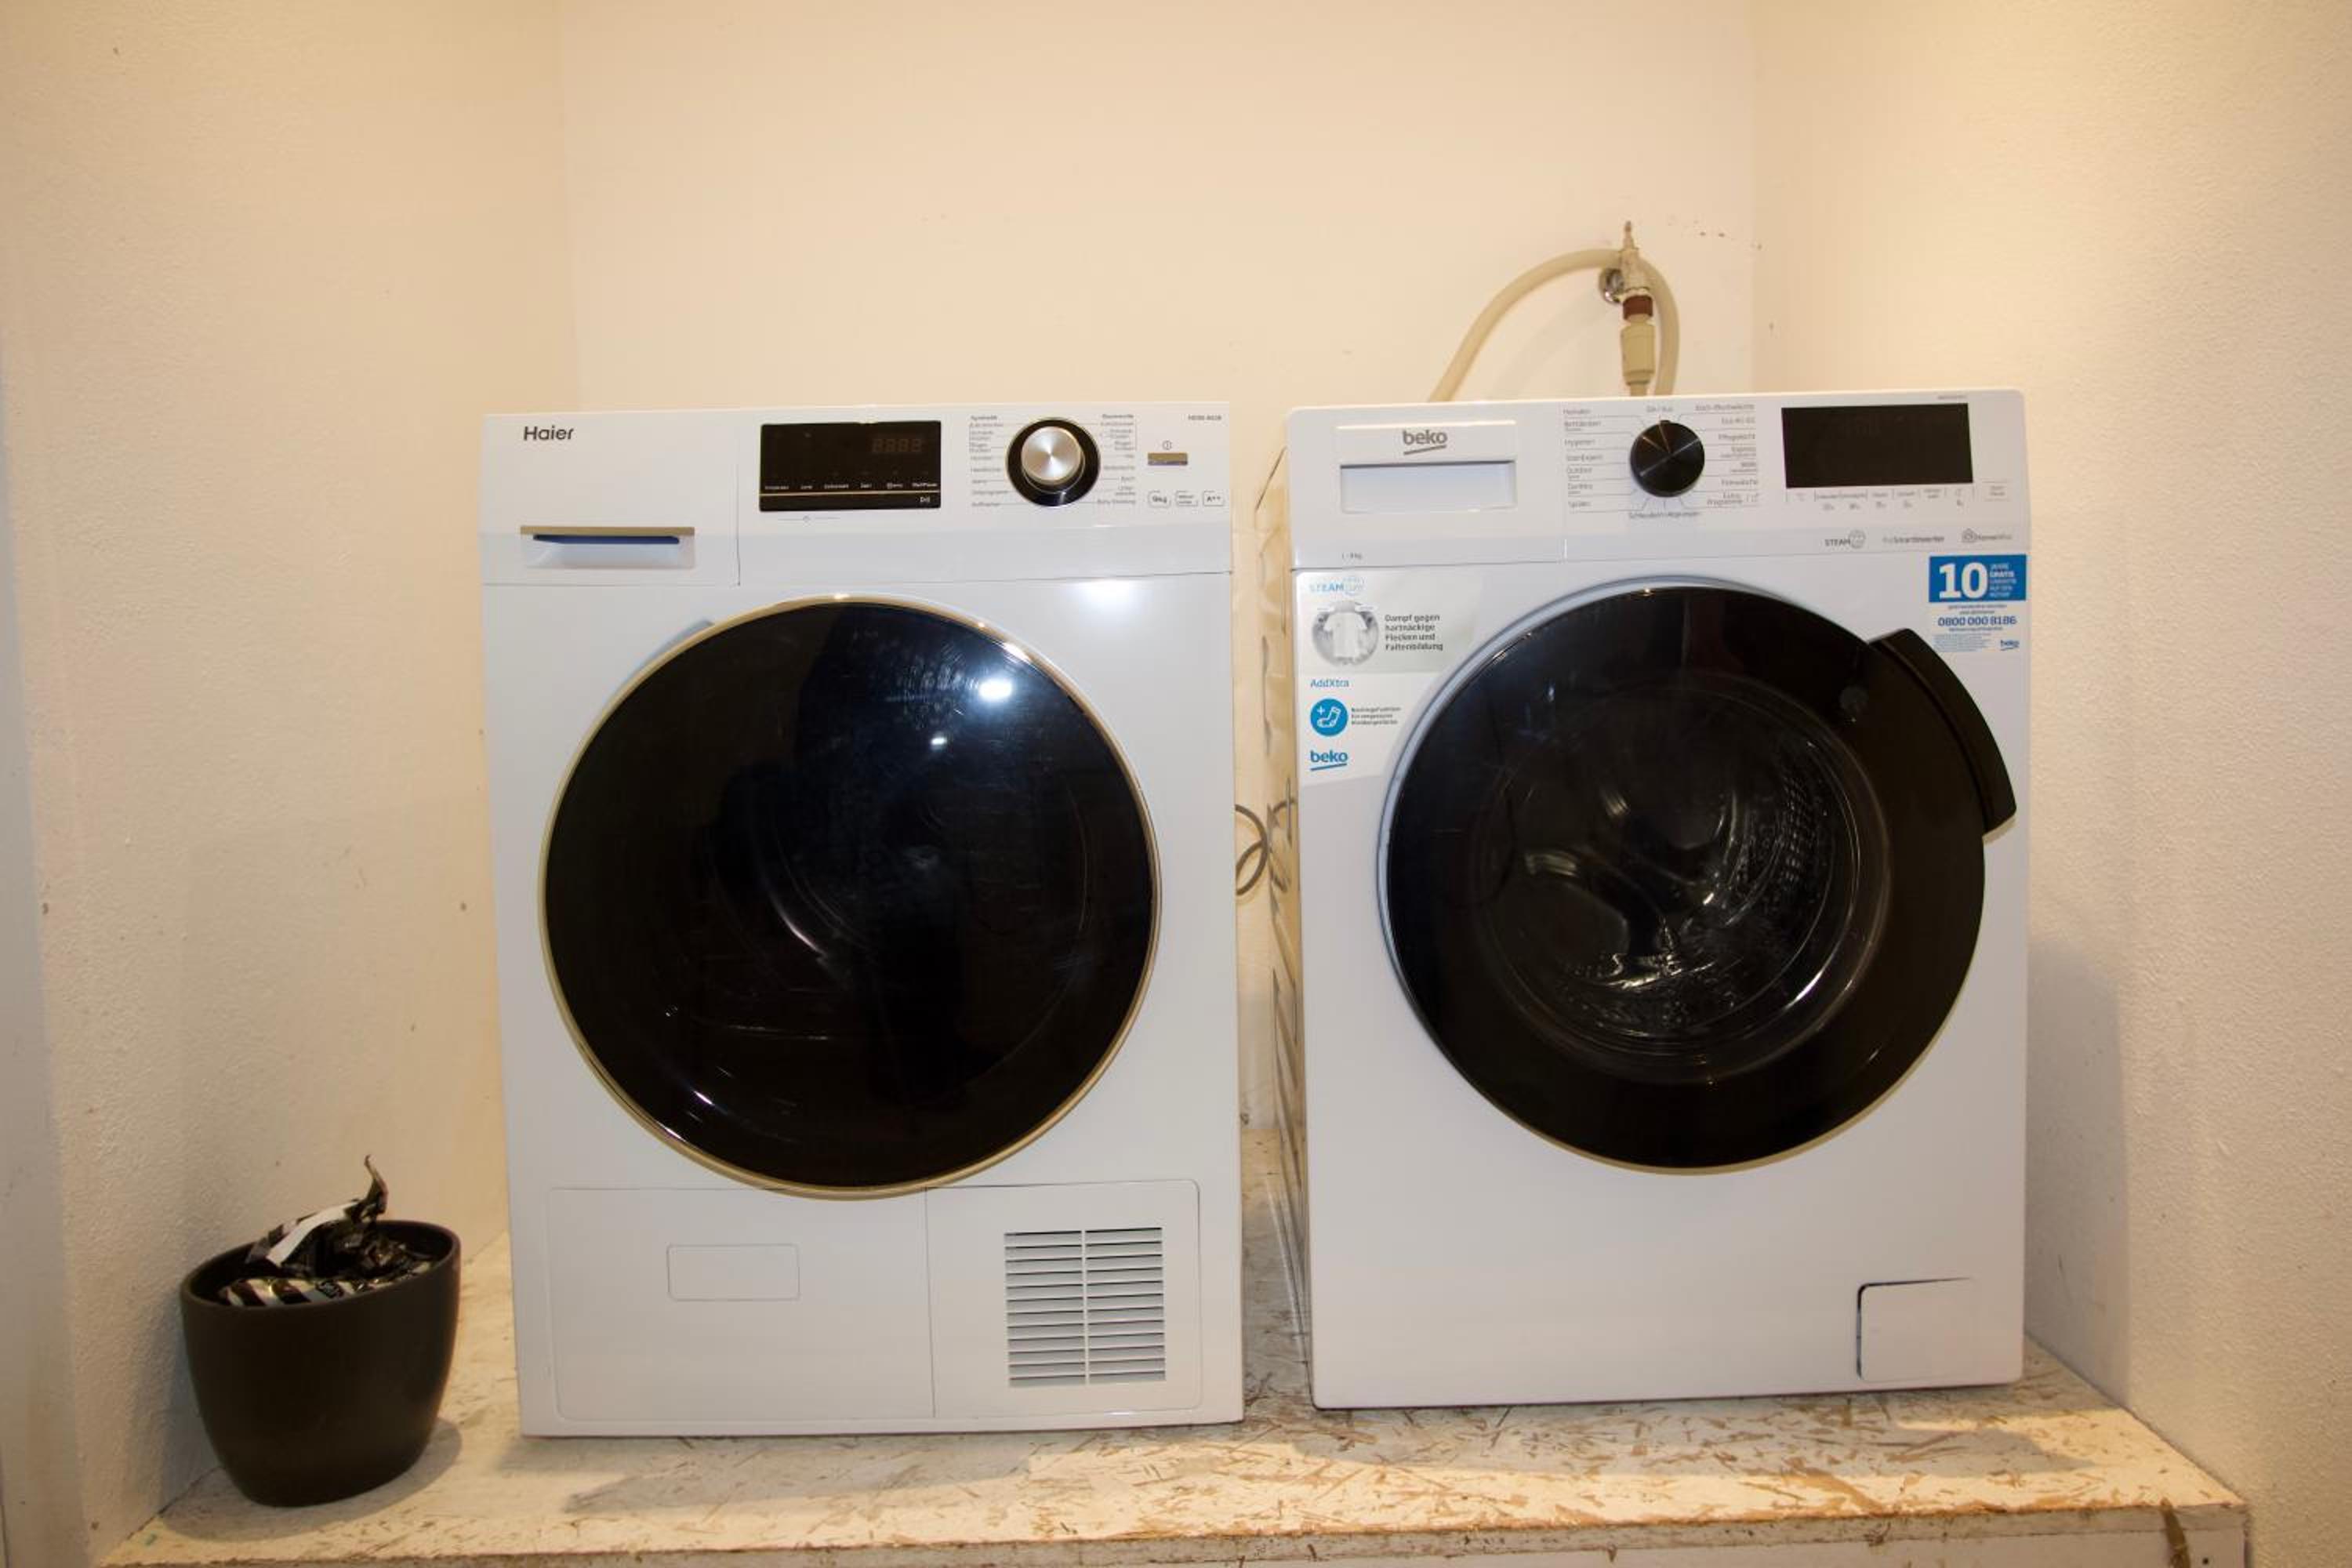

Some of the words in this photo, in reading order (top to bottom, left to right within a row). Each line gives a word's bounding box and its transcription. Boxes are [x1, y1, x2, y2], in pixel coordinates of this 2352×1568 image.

[523, 425, 575, 442] Haier
[1403, 429, 1448, 448] beko
[1824, 538, 1851, 547] STEAM
[1939, 561, 1988, 600] 10
[1385, 614, 1413, 623] Dampf
[1414, 614, 1440, 623] gegen
[1938, 617, 1965, 626] 0800
[1967, 616, 1989, 626] 000
[1990, 615, 2017, 625] 8186
[1385, 624, 1436, 633] hartnäckige
[1385, 643, 1443, 652] Faltenbildung
[1310, 679, 1349, 688] AddXtra
[1310, 750, 1348, 763] beko
